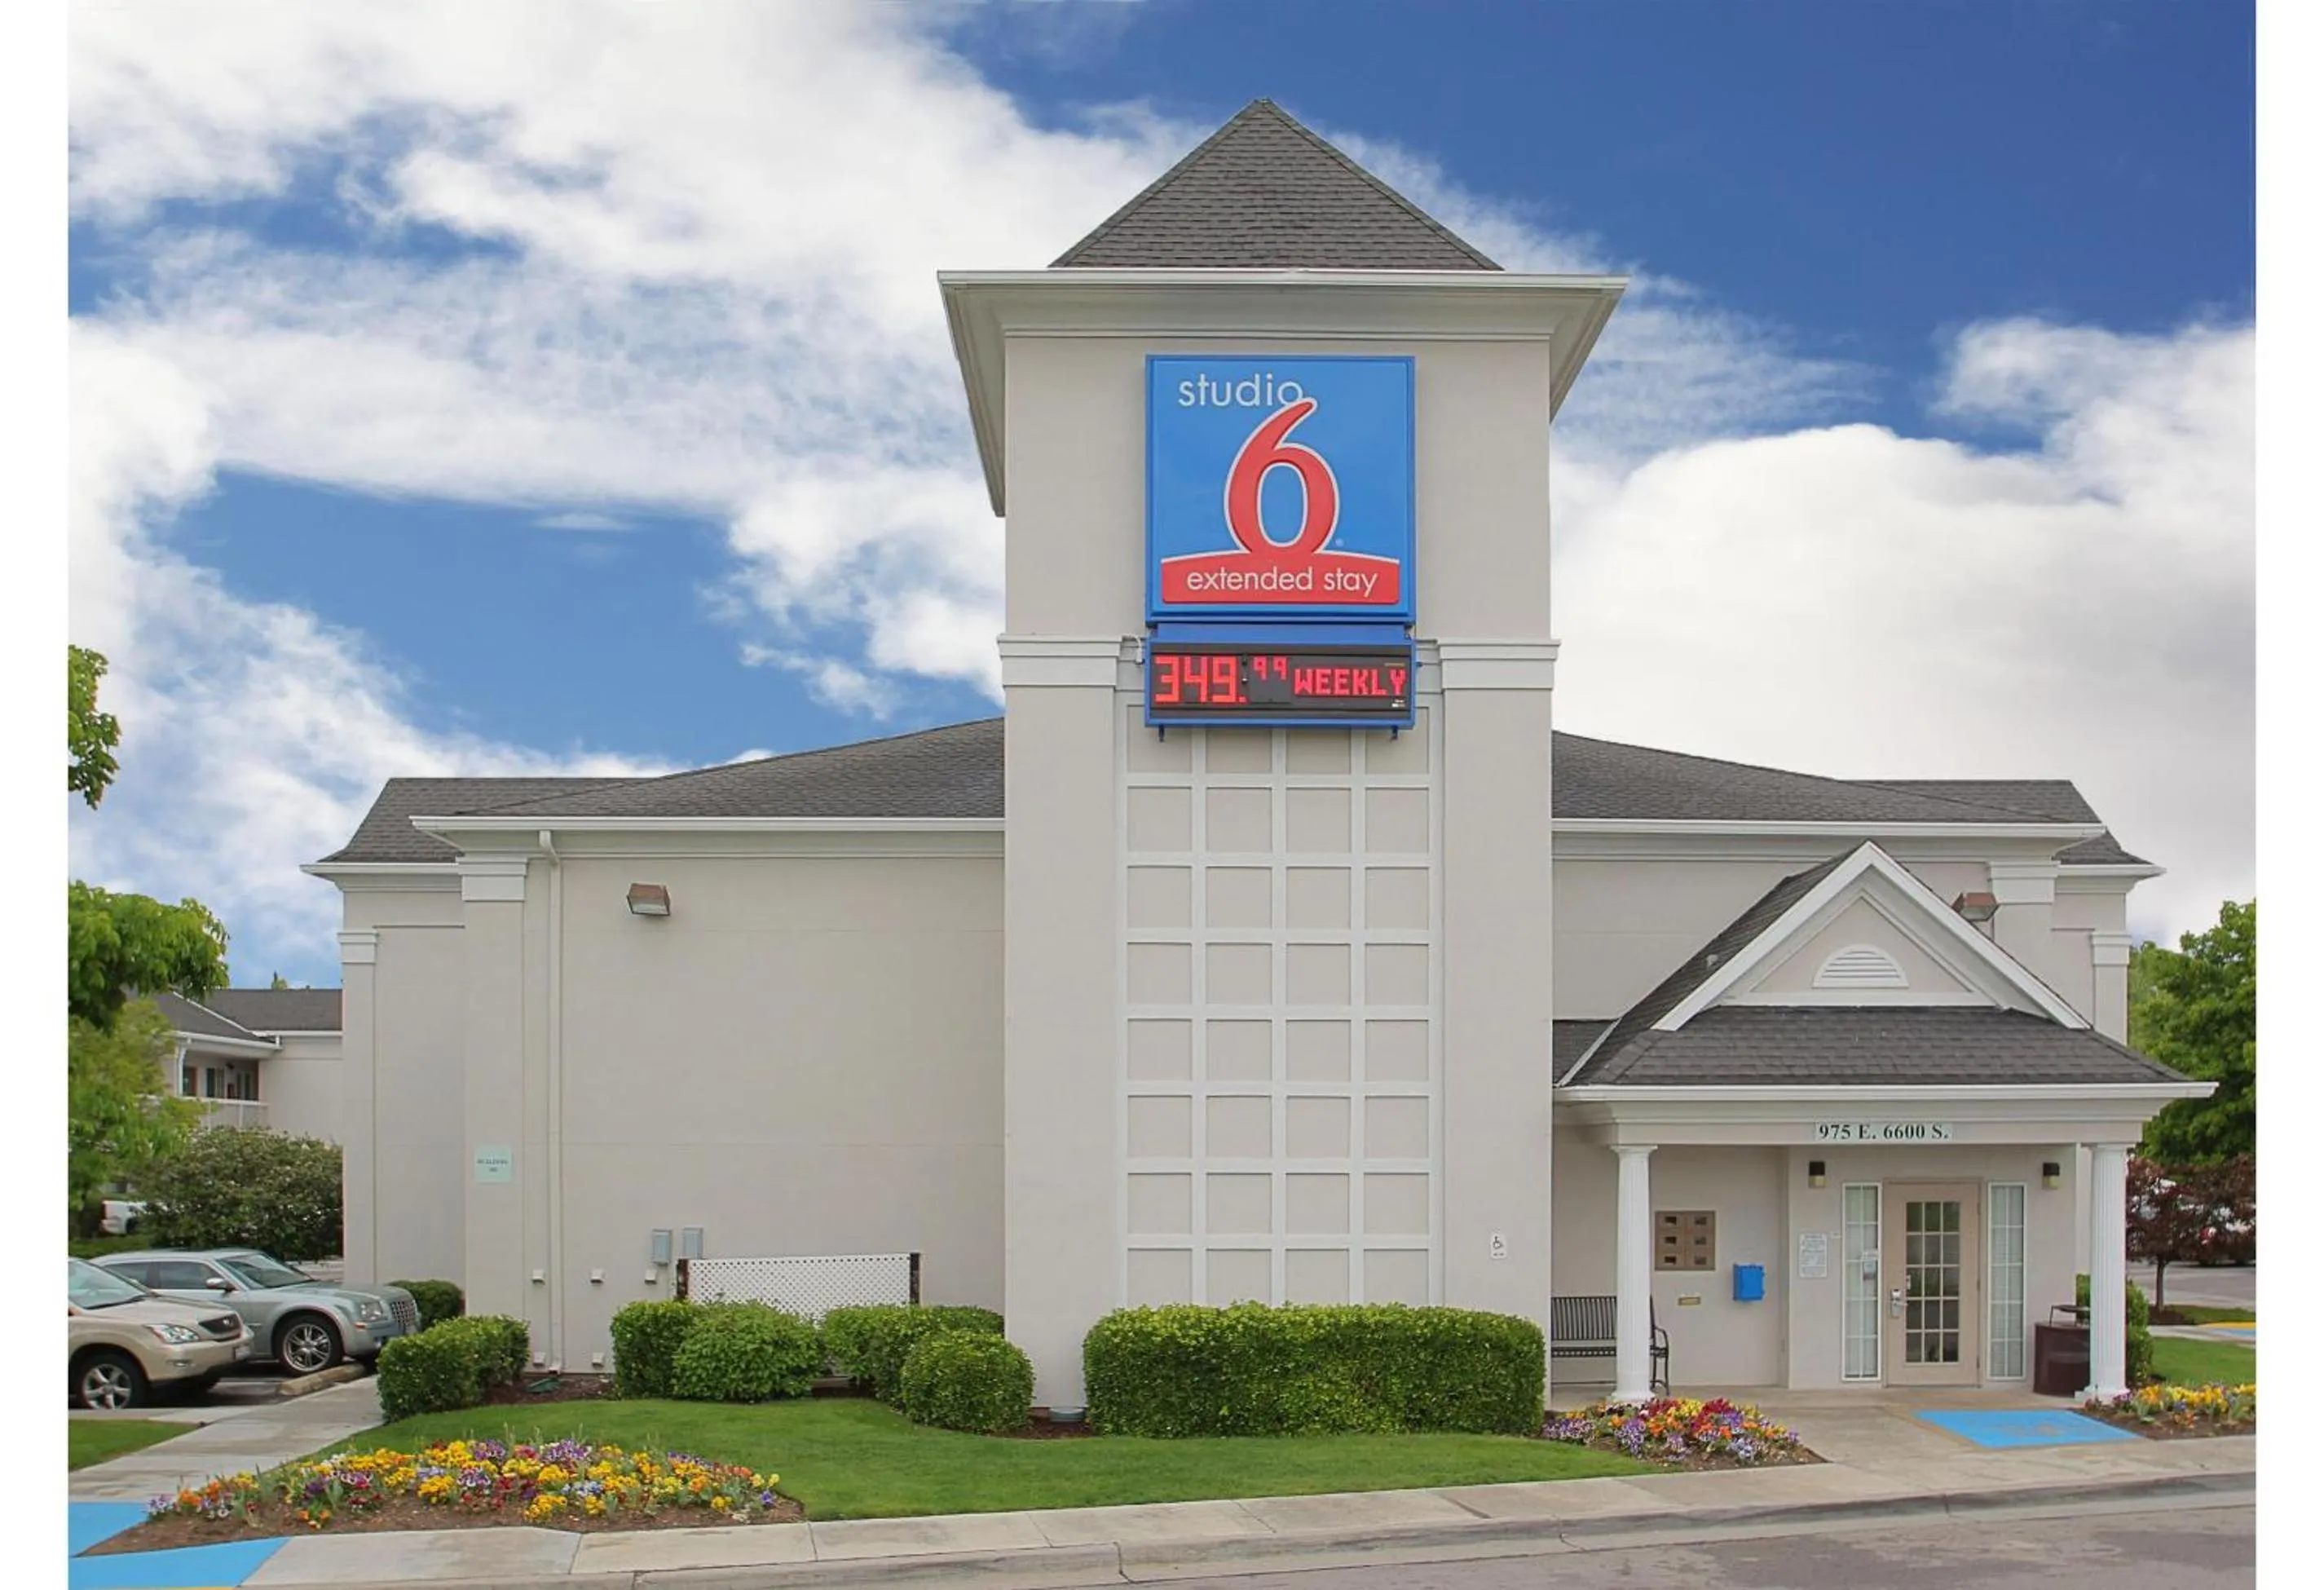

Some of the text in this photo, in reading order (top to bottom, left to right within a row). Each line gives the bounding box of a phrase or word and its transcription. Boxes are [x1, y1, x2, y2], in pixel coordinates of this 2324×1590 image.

[1178, 373, 1304, 407] studio
[1224, 397, 1339, 554] 6
[1187, 567, 1378, 598] extended stay
[1294, 668, 1406, 696] WEEKLY
[1819, 1124, 1948, 1139] 975 E. 6600 S.
